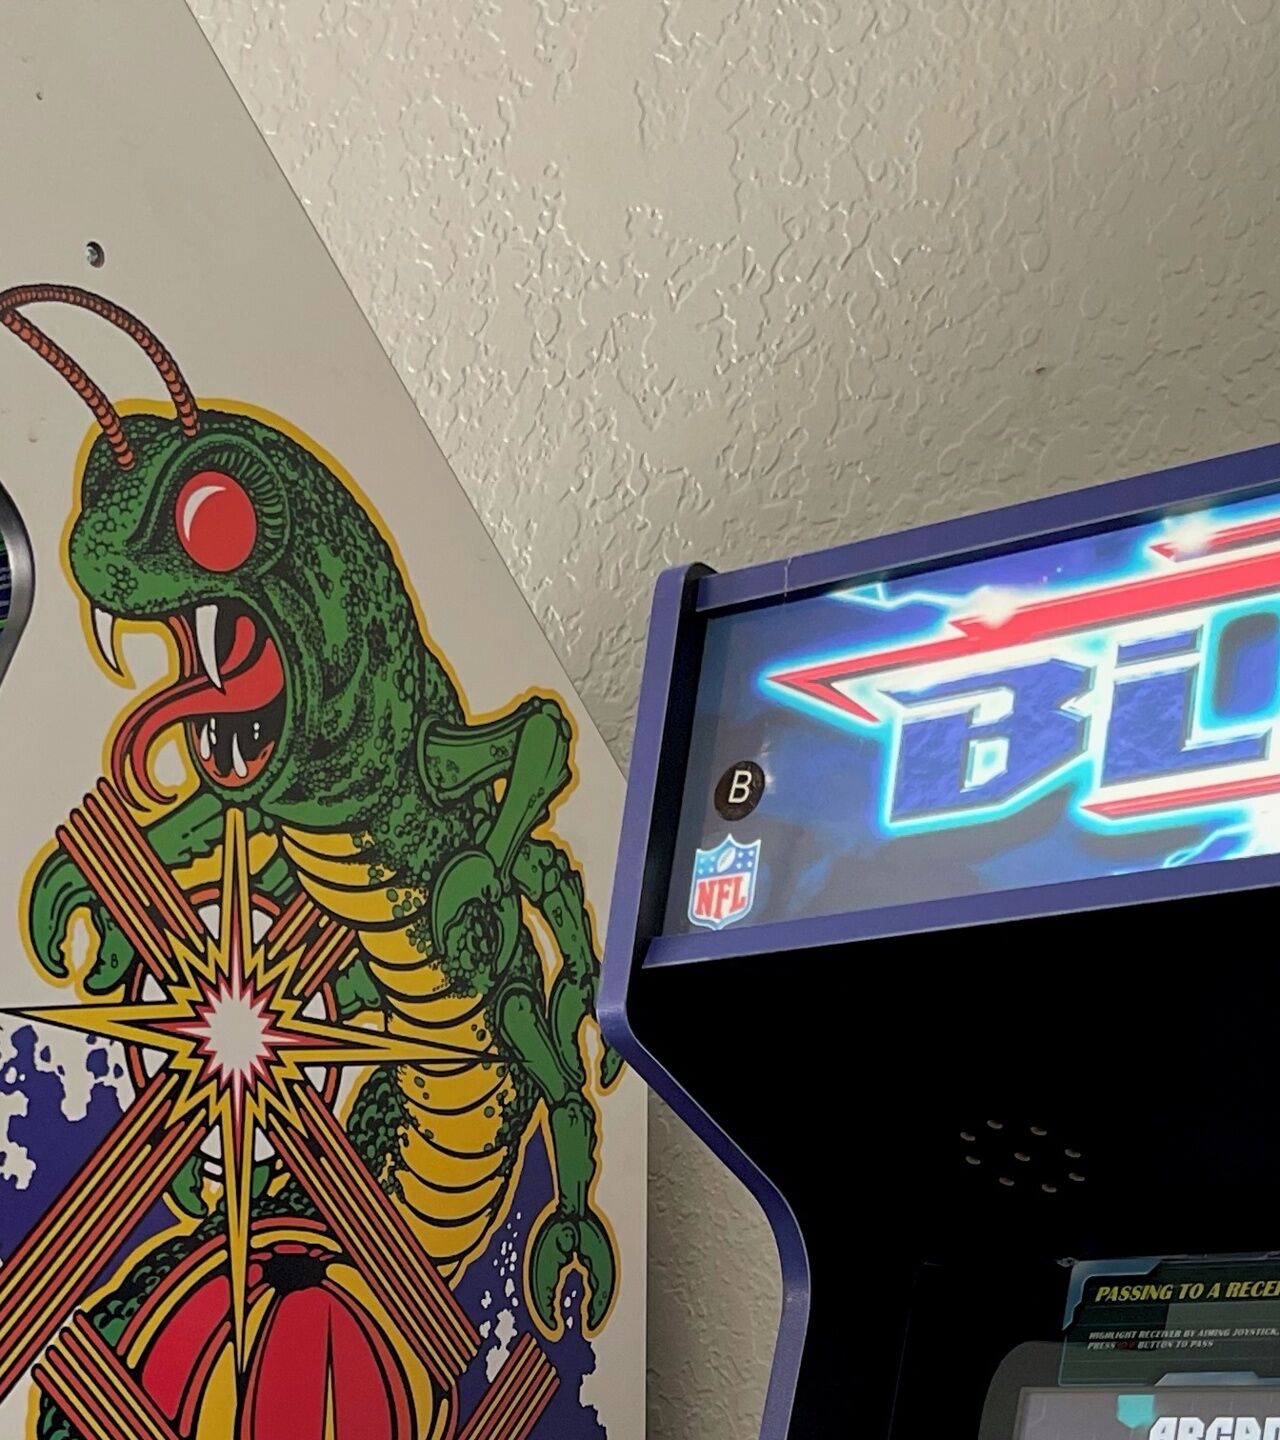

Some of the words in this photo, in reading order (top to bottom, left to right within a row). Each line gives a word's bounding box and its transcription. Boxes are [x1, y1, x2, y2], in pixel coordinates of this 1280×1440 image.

[727, 769, 753, 804] B
[694, 874, 748, 920] NFL
[1095, 1281, 1173, 1302] PASSING
[1177, 1281, 1202, 1300] TO
[1206, 1282, 1221, 1299] A
